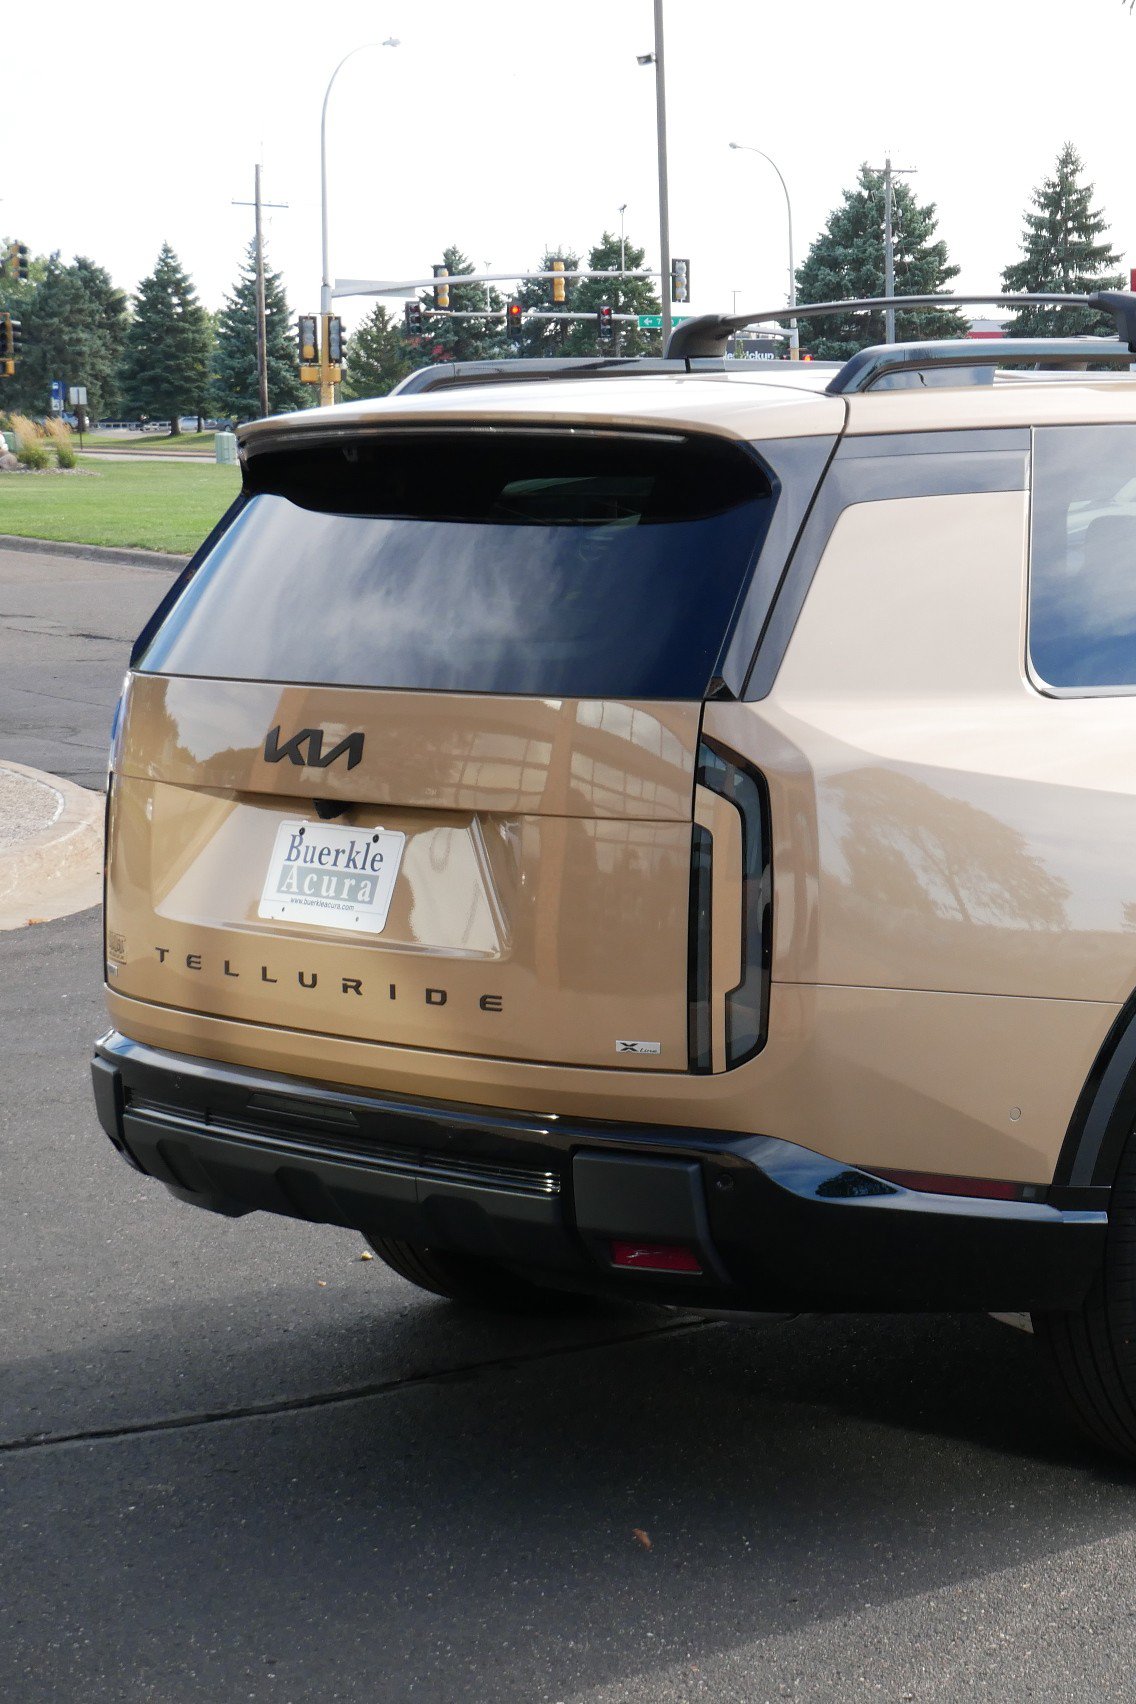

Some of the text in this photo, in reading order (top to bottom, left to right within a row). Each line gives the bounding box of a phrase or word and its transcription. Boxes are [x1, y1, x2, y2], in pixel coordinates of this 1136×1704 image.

[741, 350, 775, 360] ickup
[263, 725, 365, 771] KIA
[284, 833, 384, 872] Buerkle
[281, 865, 371, 902] Acura
[290, 897, 355, 911] www.buerkleacura.com
[155, 947, 504, 1012] TELLURIDE
